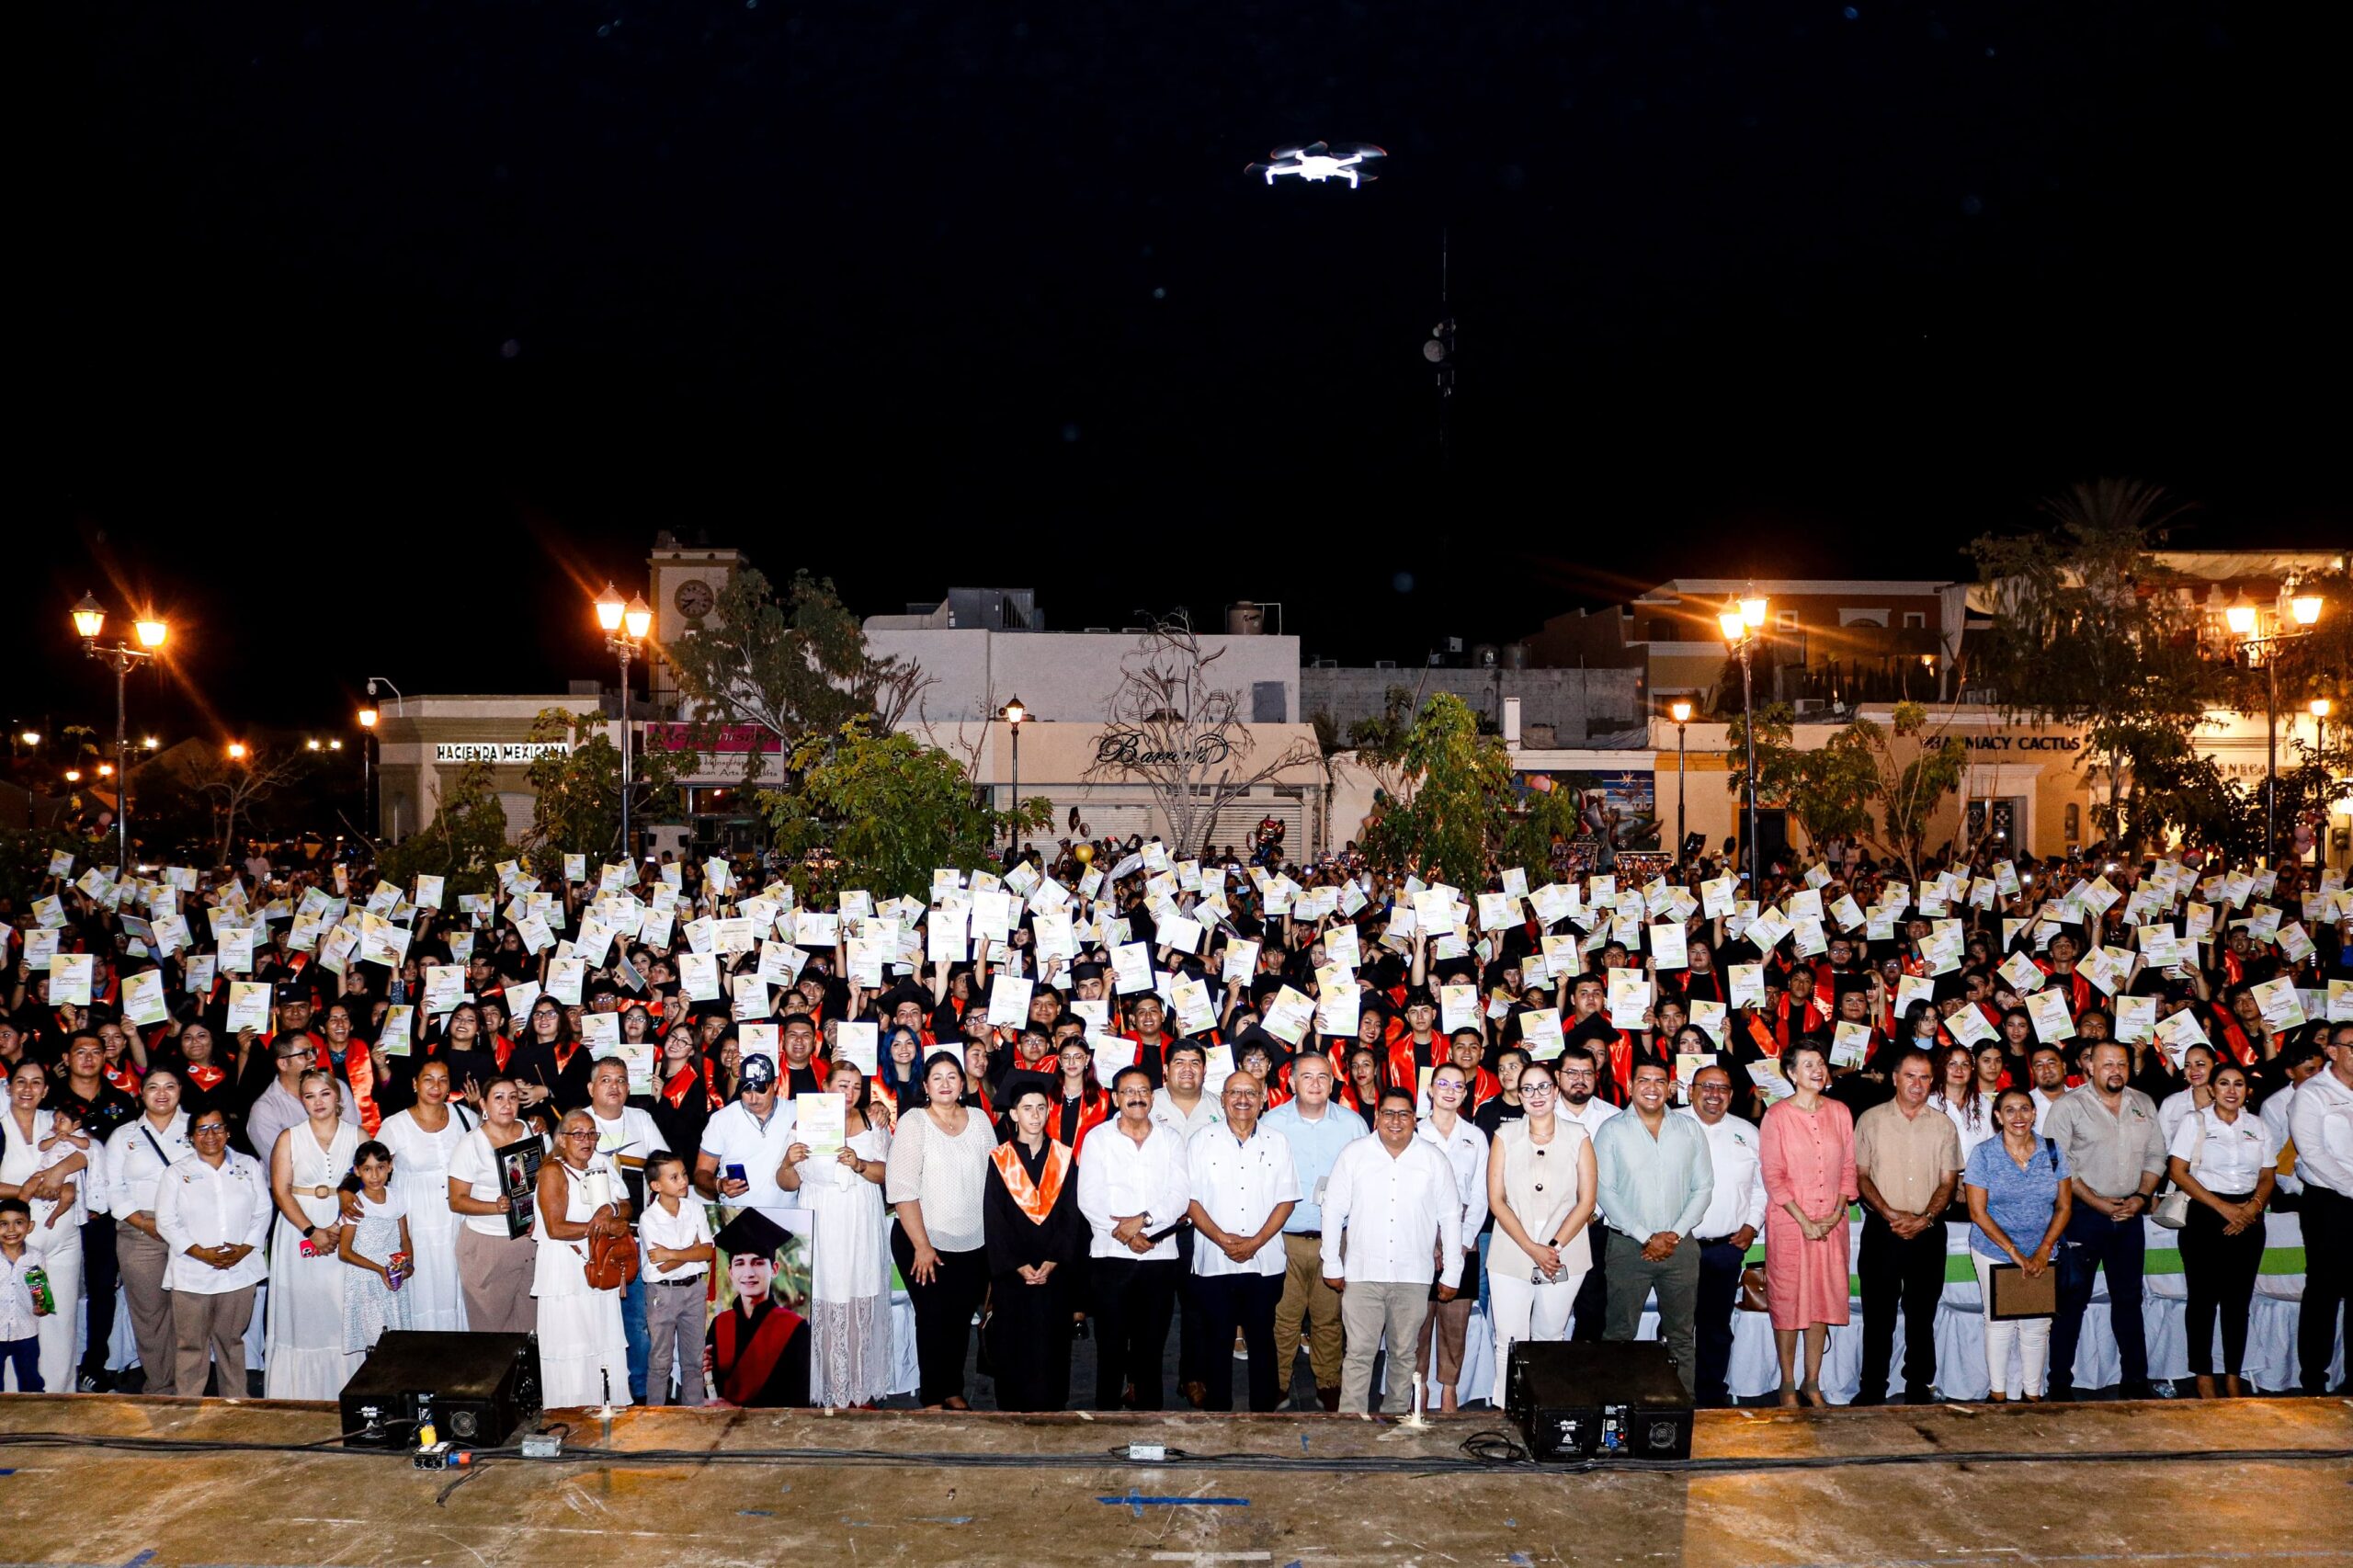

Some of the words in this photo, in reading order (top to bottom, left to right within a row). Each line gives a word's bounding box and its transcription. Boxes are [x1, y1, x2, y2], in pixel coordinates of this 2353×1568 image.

[2018, 736, 2080, 750] CACTUS
[437, 745, 497, 759] HACIENDA
[719, 768, 739, 777] Arts
